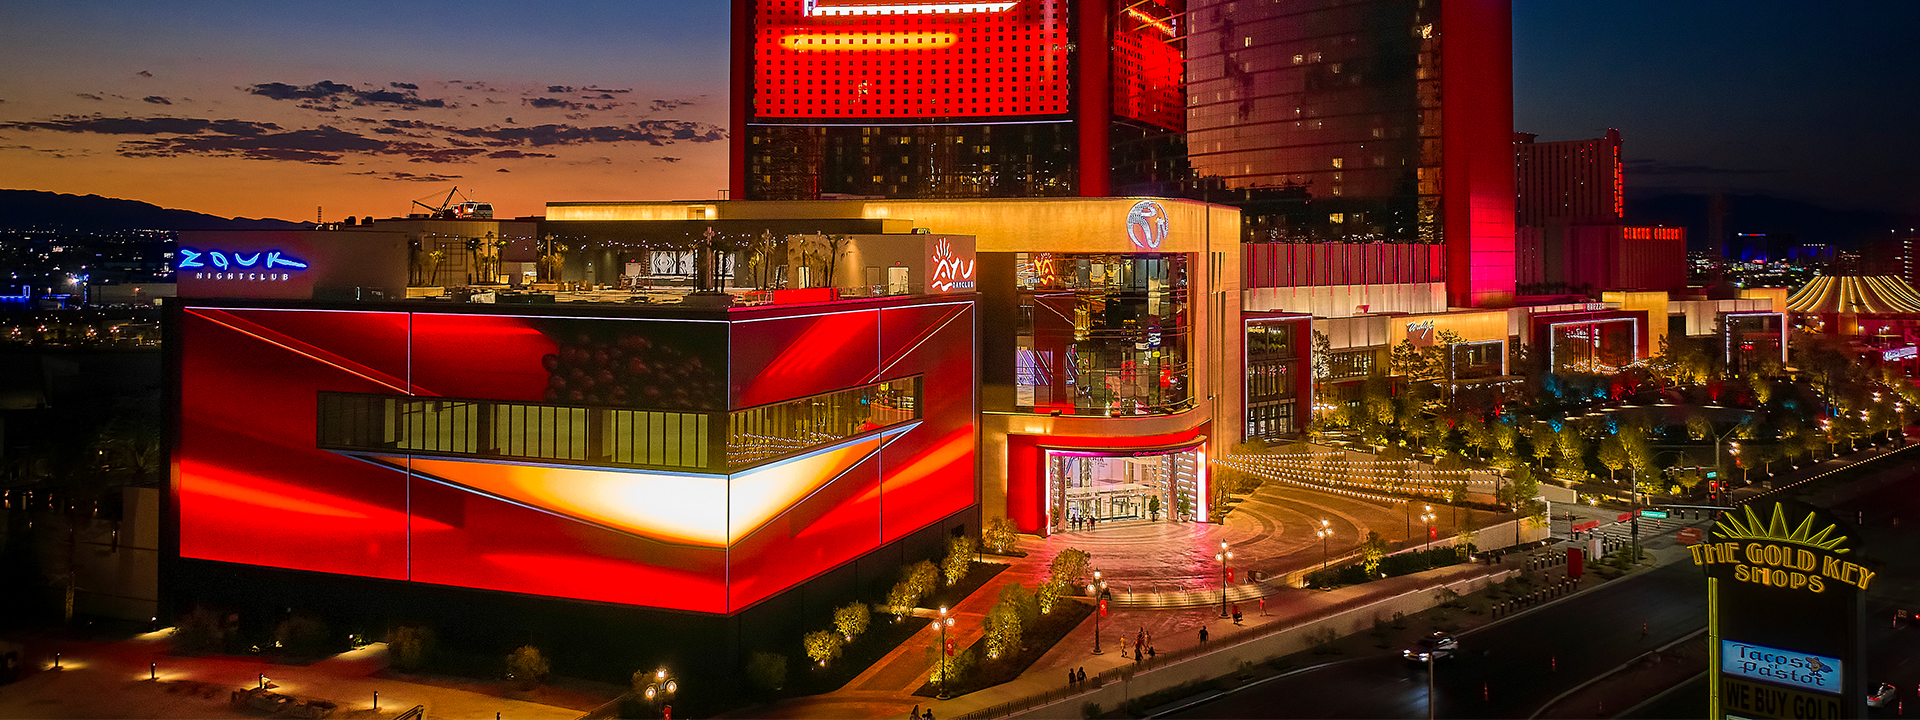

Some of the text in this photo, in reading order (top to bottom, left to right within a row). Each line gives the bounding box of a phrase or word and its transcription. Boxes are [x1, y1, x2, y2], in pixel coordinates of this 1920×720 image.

[1623, 226, 1680, 240] CIRCUS CIRCUS
[178, 249, 308, 271] ZOUK
[196, 272, 290, 281] NIGHTCLUB
[1686, 542, 1877, 591] THE GOLD KEY
[1734, 563, 1826, 594] SHOPS
[1732, 643, 1803, 669] Tacos
[1737, 659, 1827, 687] Pastor
[1725, 681, 1839, 720] WE BUY GOLD
